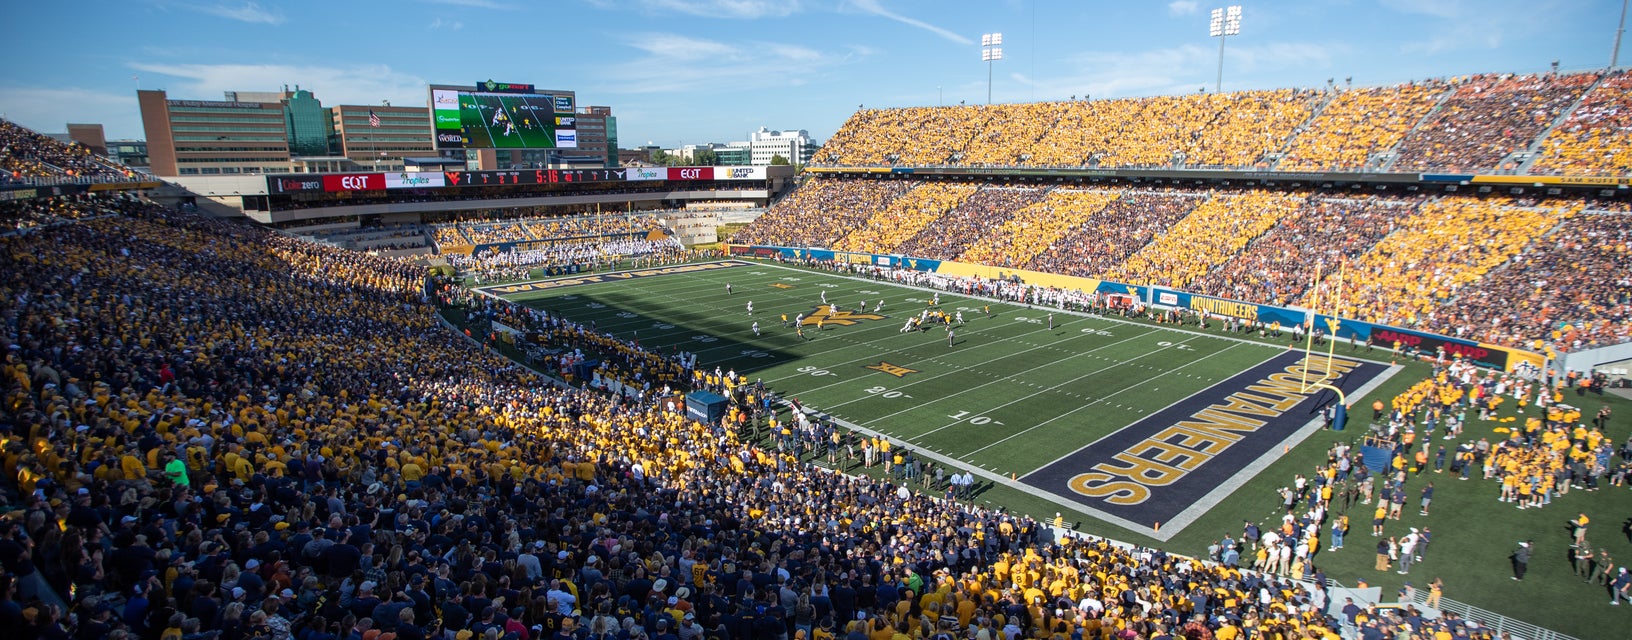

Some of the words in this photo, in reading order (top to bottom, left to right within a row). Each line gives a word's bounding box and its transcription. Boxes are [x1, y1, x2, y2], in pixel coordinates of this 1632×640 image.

[536, 169, 558, 184] 5:16
[681, 168, 701, 179] EQT
[341, 175, 369, 189] EQT
[493, 276, 603, 293] WEST
[1190, 296, 1258, 322] MOUNTAINEERS
[797, 366, 830, 377] 30
[864, 386, 903, 399] 20
[948, 410, 991, 427] 10
[1067, 355, 1363, 505] MOUNTAINEERS
